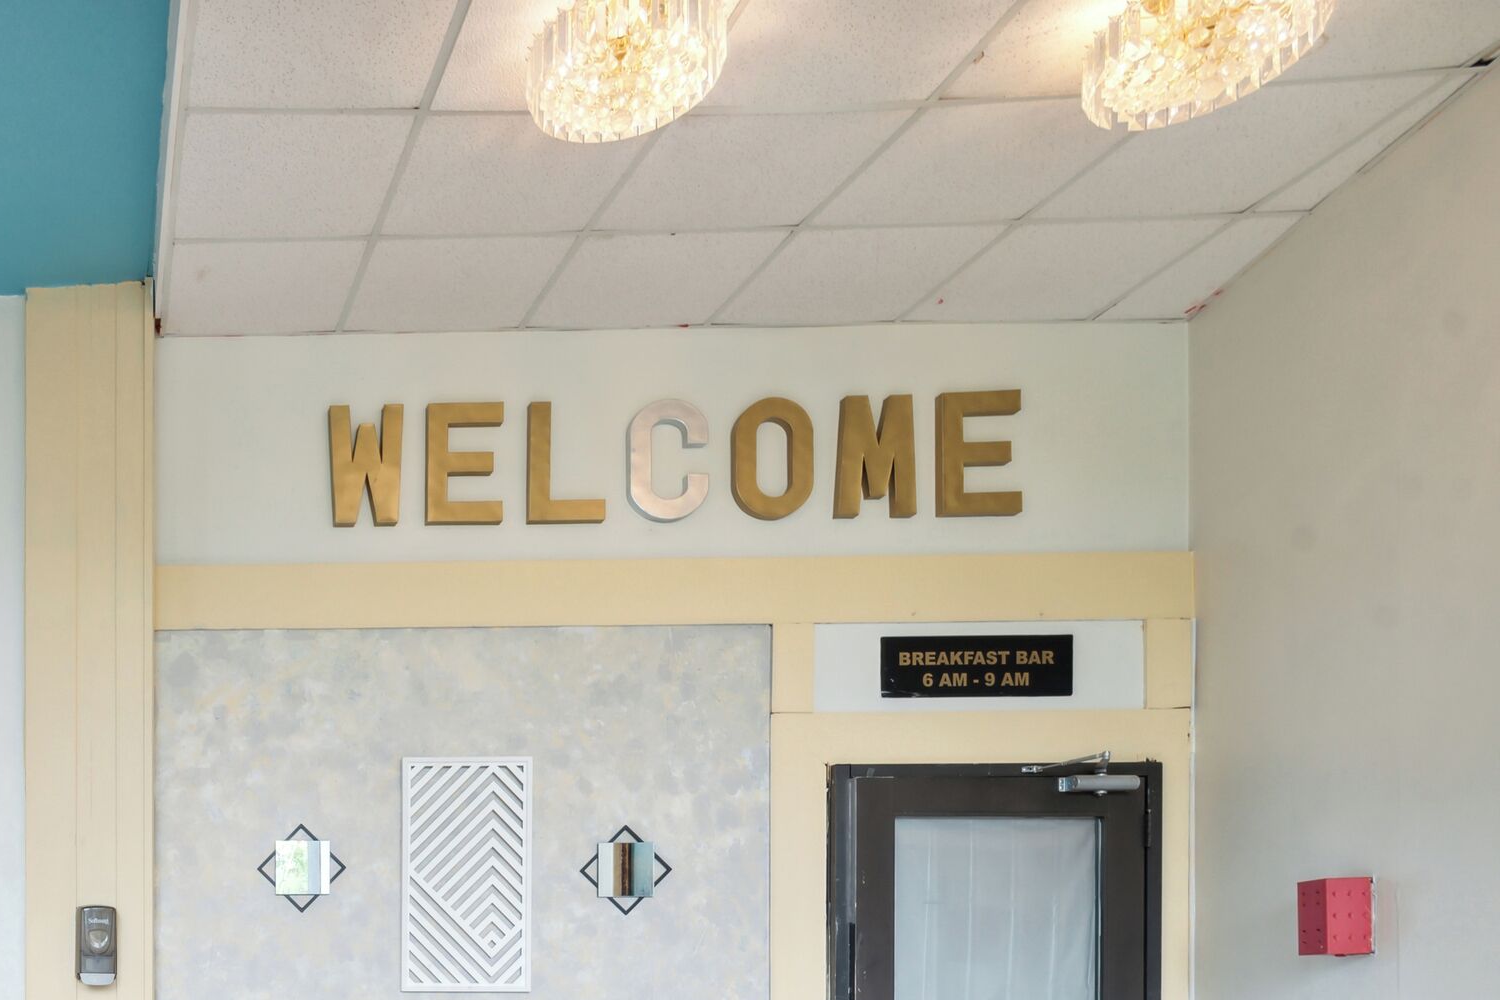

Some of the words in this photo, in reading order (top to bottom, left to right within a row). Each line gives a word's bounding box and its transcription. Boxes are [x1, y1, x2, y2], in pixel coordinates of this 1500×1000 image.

[328, 389, 1023, 527] WELCOME
[898, 650, 1010, 667] BREAKFAST
[1015, 650, 1055, 666] BAR
[922, 672, 934, 688] 6
[938, 672, 968, 687] AM
[984, 672, 996, 687] 9
[1000, 672, 1030, 687] AM
